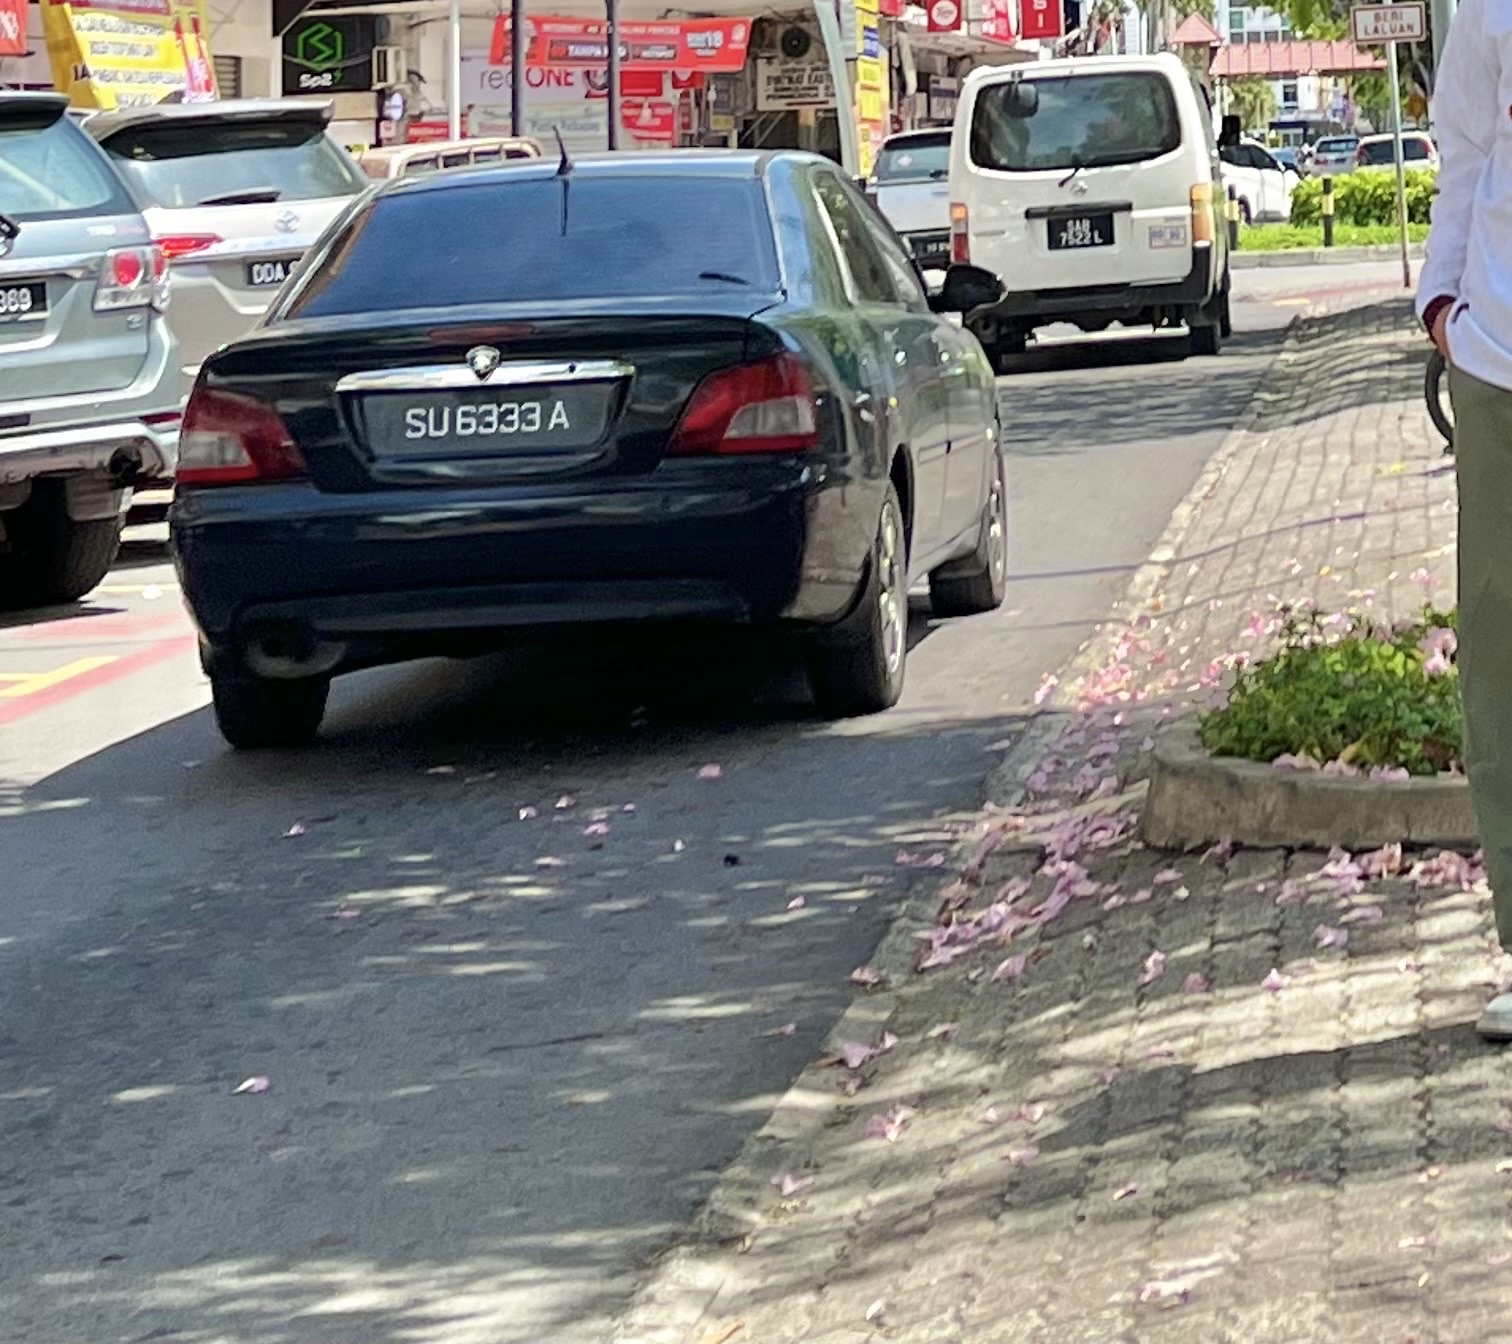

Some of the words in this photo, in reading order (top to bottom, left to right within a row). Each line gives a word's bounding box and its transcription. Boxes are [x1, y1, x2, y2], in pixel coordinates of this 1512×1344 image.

[1363, 23, 1415, 36] LALUAN
[404, 406, 451, 439] SU
[455, 401, 542, 436] 6333
[547, 400, 570, 431] A
